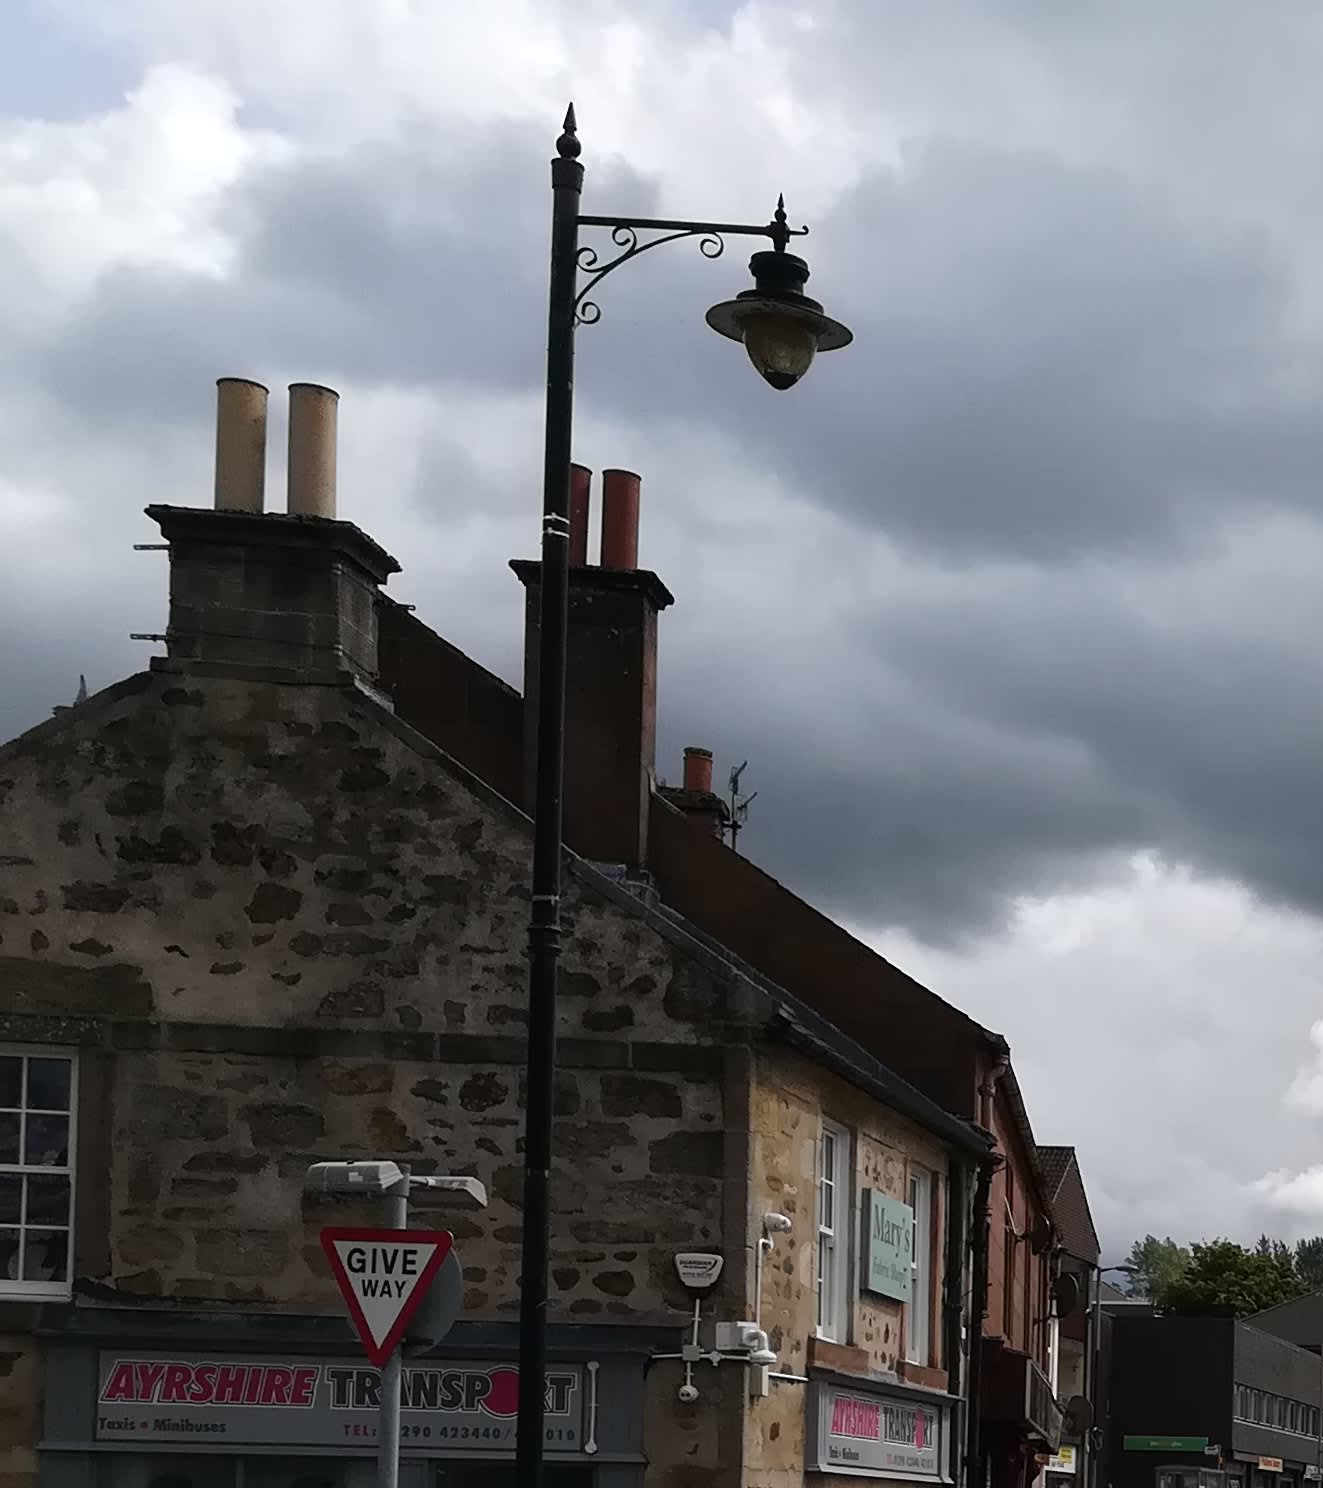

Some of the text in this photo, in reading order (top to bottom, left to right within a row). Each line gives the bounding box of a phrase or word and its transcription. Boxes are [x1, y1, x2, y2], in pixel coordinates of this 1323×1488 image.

[873, 1203, 911, 1258] Mary's
[347, 1248, 418, 1275] GIVE
[362, 1279, 406, 1298] WAY
[102, 1361, 319, 1408] AYRSHIRE
[98, 1417, 227, 1433] Taxis Minibuses
[343, 1425, 377, 1437] TEL:
[831, 1397, 934, 1450] AYRSHIRE TRANSPORT
